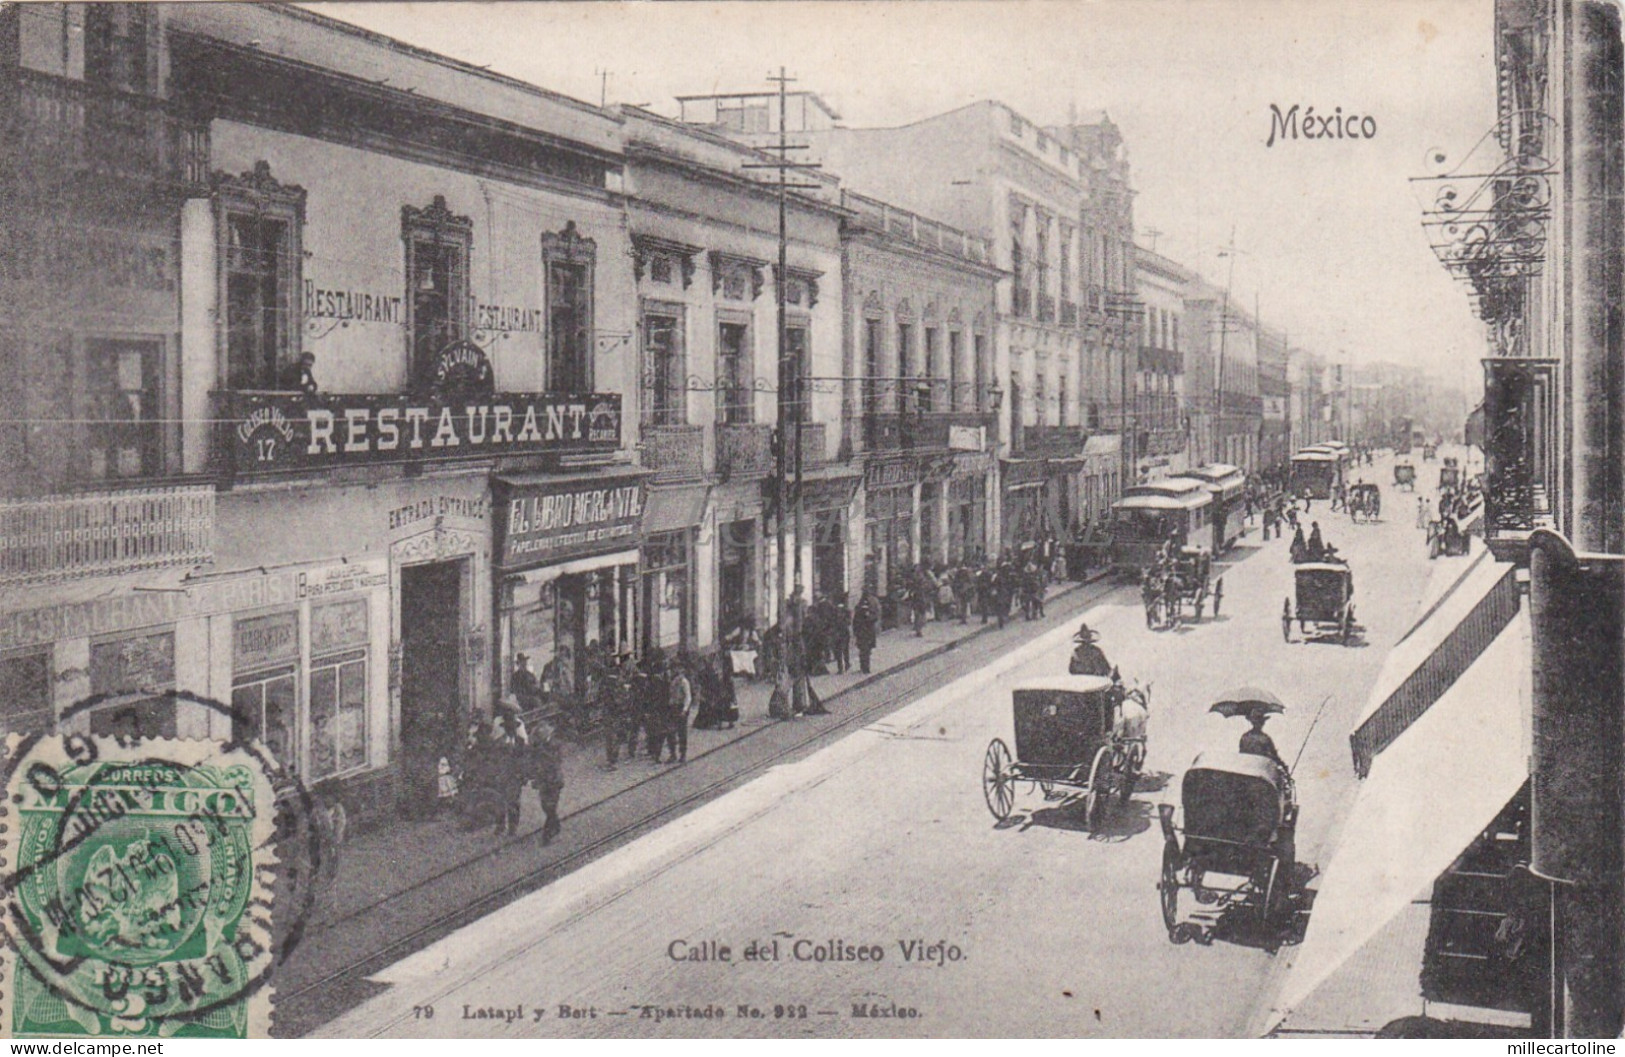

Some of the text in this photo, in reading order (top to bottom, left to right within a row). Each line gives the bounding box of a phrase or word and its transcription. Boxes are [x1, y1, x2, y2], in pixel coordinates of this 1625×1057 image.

[304, 279, 400, 324] RESTAURANT
[257, 438, 276, 462] 17
[306, 403, 587, 455] RESTAURANT
[388, 495, 484, 530] ENTRADA ENTRANCE
[508, 499, 530, 535] EL
[531, 492, 573, 532] LIBRO
